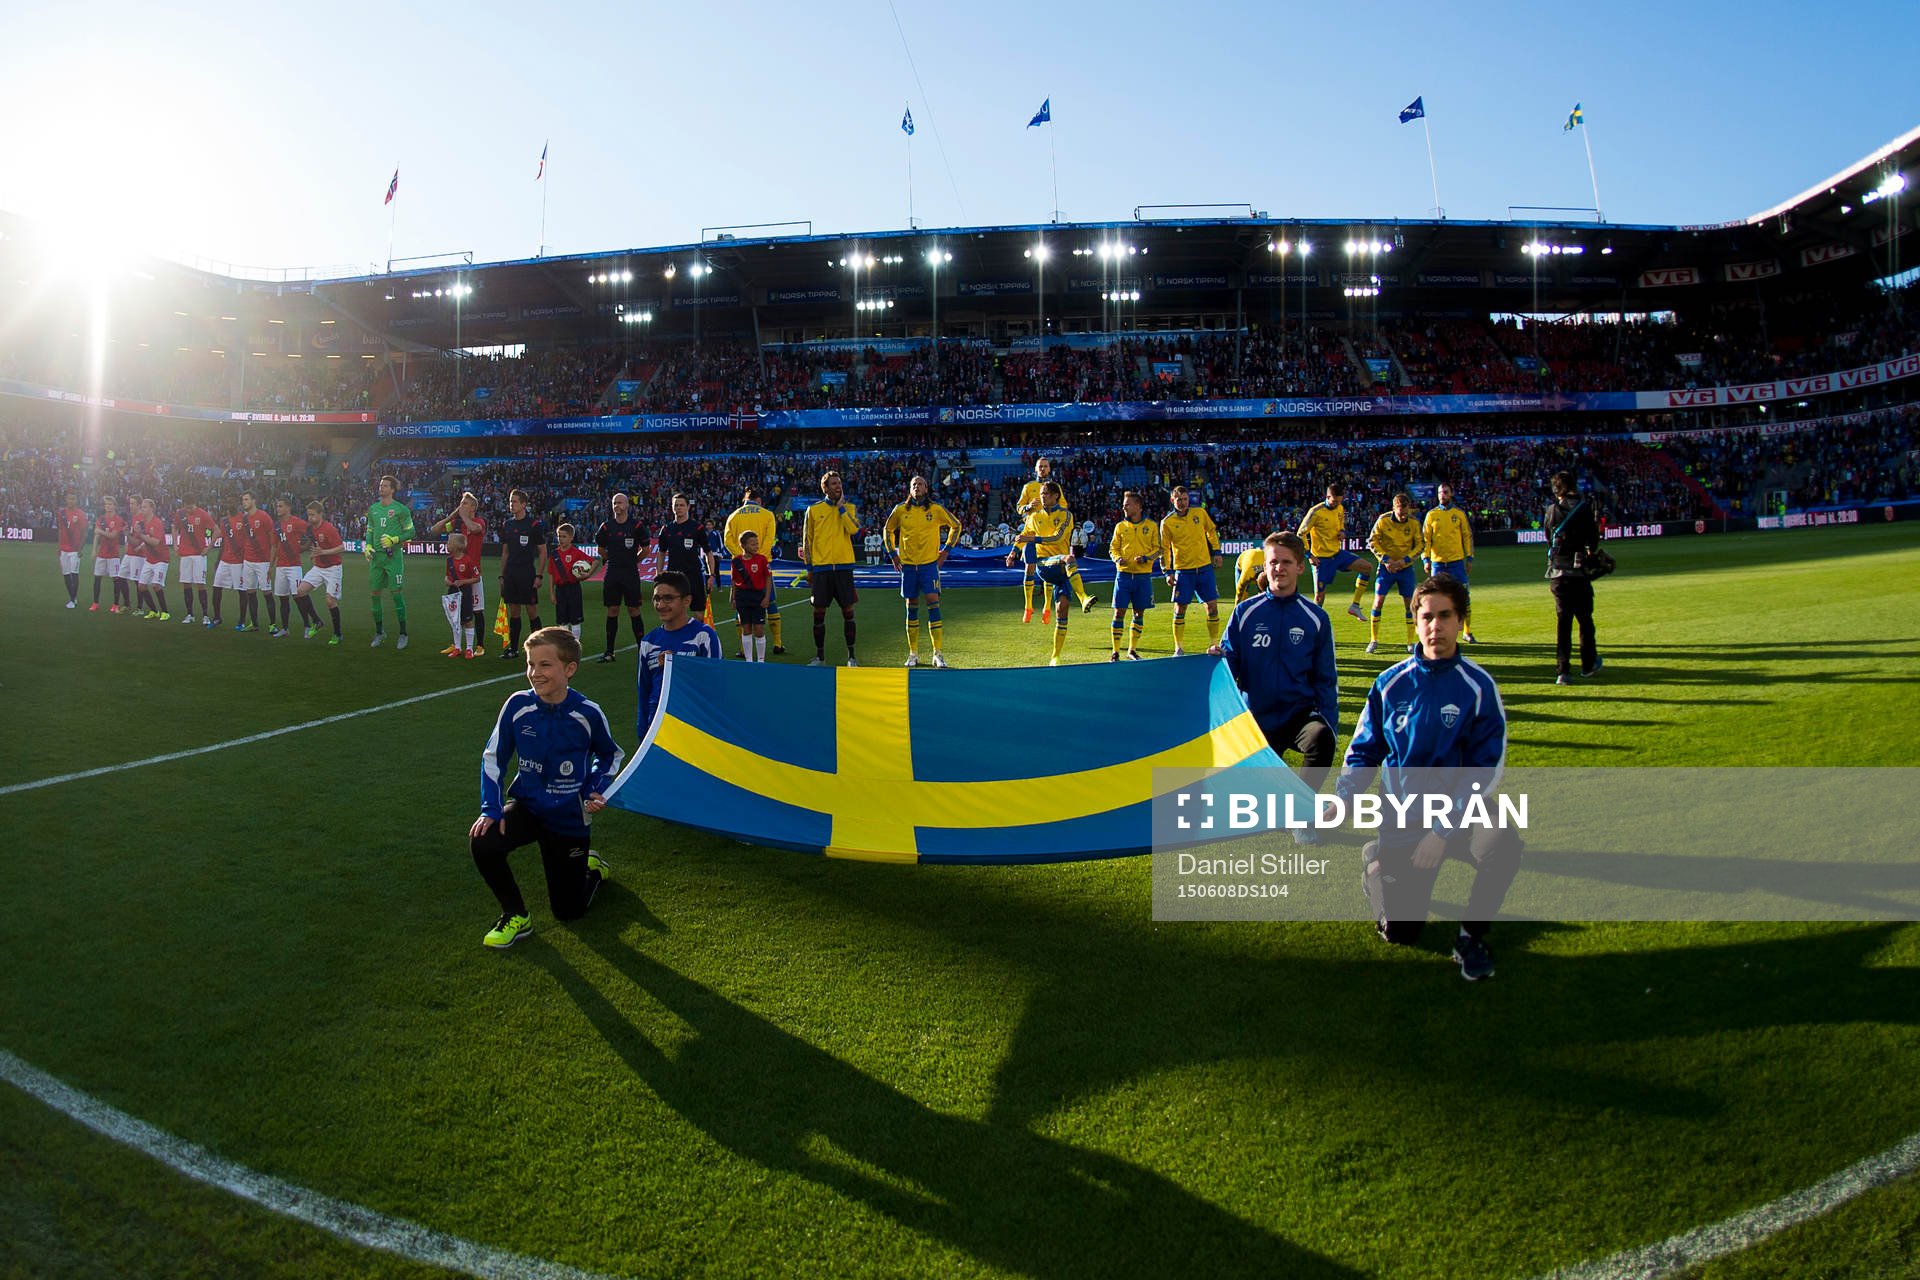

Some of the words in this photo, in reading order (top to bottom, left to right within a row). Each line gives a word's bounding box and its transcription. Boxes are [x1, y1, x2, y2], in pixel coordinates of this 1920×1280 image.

[1807, 243, 1849, 264] VG
[1649, 270, 1691, 284] VG
[1732, 262, 1775, 279] VG
[969, 283, 998, 292] NORSK
[999, 281, 1030, 290] TIPPING
[1167, 277, 1193, 285] NORSK
[1194, 276, 1226, 284] TIPPING
[779, 292, 807, 300] NORSK
[808, 290, 837, 298] TIPPING
[1887, 357, 1919, 378] VG
[1839, 367, 1878, 387] VG
[1728, 385, 1776, 401] VG
[1786, 378, 1827, 396] VG
[1670, 391, 1713, 406] VG
[1279, 402, 1322, 413] NORSK
[1324, 400, 1372, 412] TIPPING
[956, 409, 1001, 420] NORSK
[1004, 407, 1056, 418] TIPPING
[646, 416, 689, 428] NORSK
[689, 415, 731, 427] TIPPIN
[1794, 420, 1816, 430] VG
[388, 425, 422, 435] NORSK
[423, 423, 461, 434] TIPPING
[1765, 423, 1790, 434] VG
[381, 517, 388, 526] 12
[1837, 509, 1859, 523] 20:00
[7, 527, 33, 540] 20:00
[280, 532, 287, 543] 14
[1604, 526, 1622, 541] juni
[1623, 525, 1635, 538] kl.
[1636, 523, 1663, 537] 20:00
[407, 542, 424, 554] juni
[426, 543, 438, 554] kl.
[1349, 538, 1363, 551] kl.
[395, 574, 403, 584] 12
[1251, 633, 1271, 648] 20
[1394, 714, 1408, 734] 9
[519, 756, 543, 773] bring
